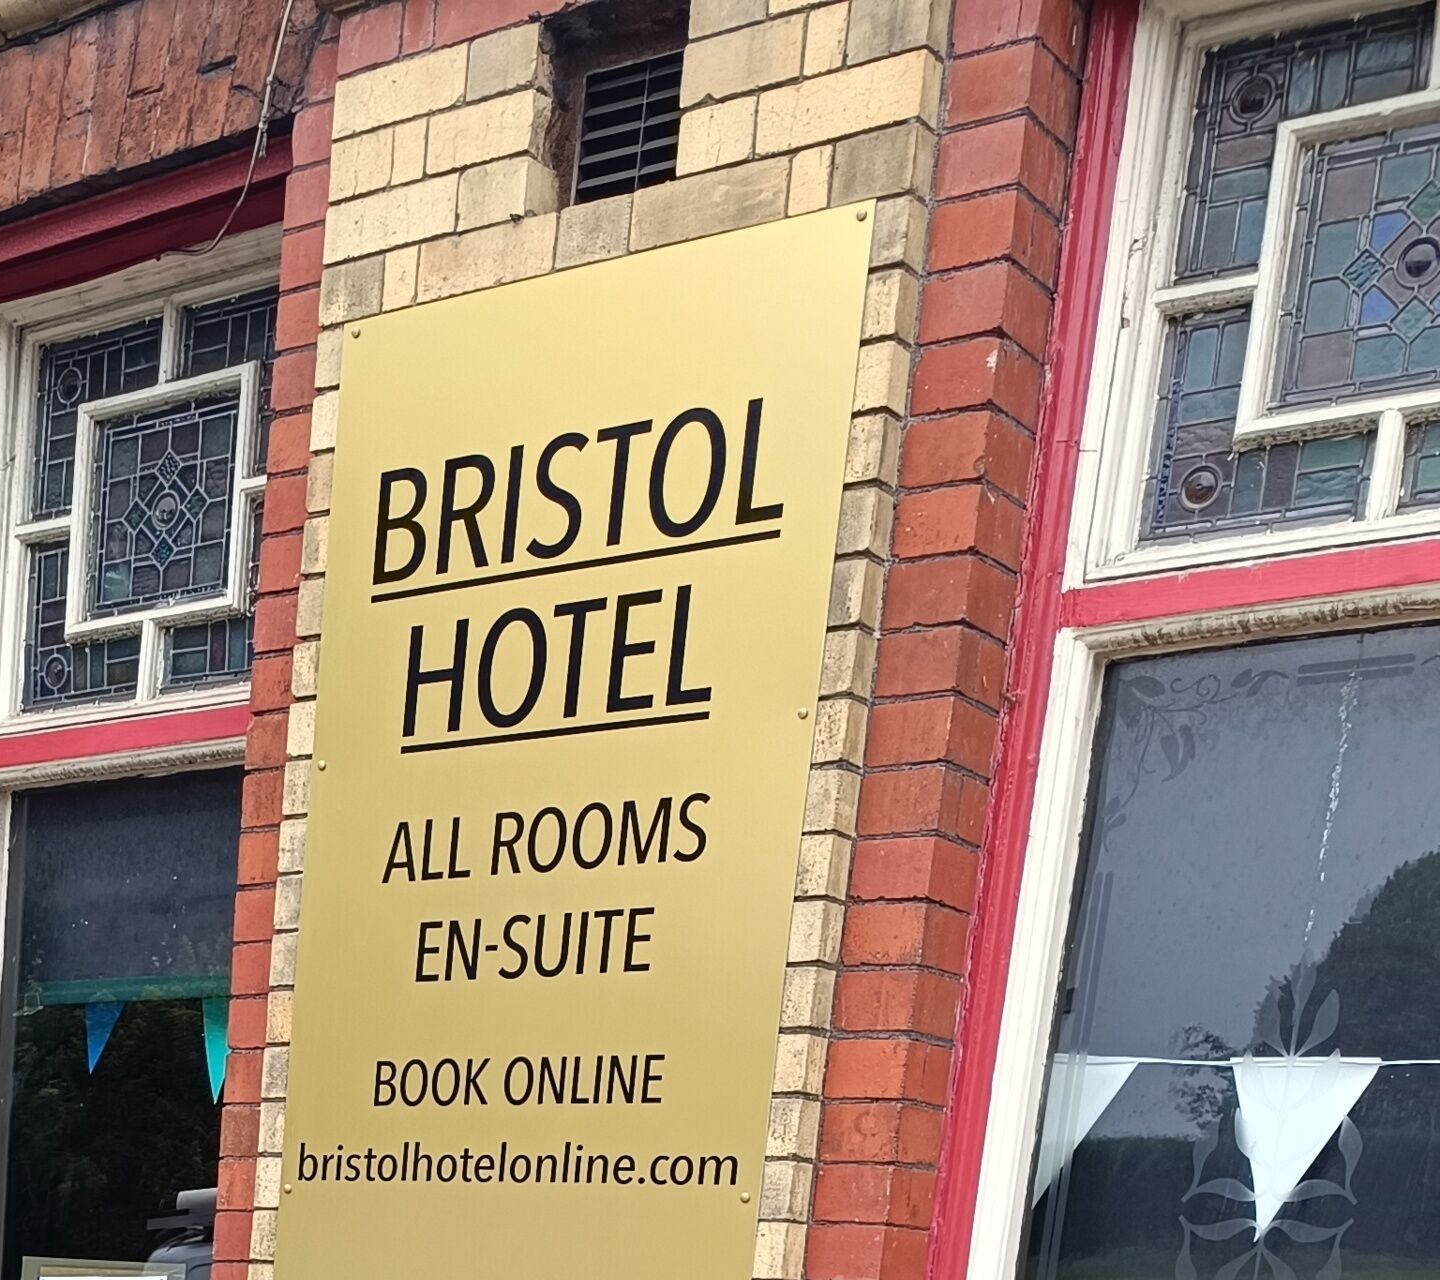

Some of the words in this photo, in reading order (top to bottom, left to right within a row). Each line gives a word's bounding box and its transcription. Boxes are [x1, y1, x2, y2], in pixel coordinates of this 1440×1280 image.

[371, 397, 784, 586] BRISTOL
[401, 584, 712, 738] HOTEL
[380, 816, 471, 885] ALL
[490, 792, 711, 876] ROOMS
[414, 906, 656, 983] EN-SUITE
[373, 1057, 491, 1107] BOOK
[503, 1054, 666, 1106] ONLINE
[296, 1141, 740, 1187] bristolhotelonline.com
